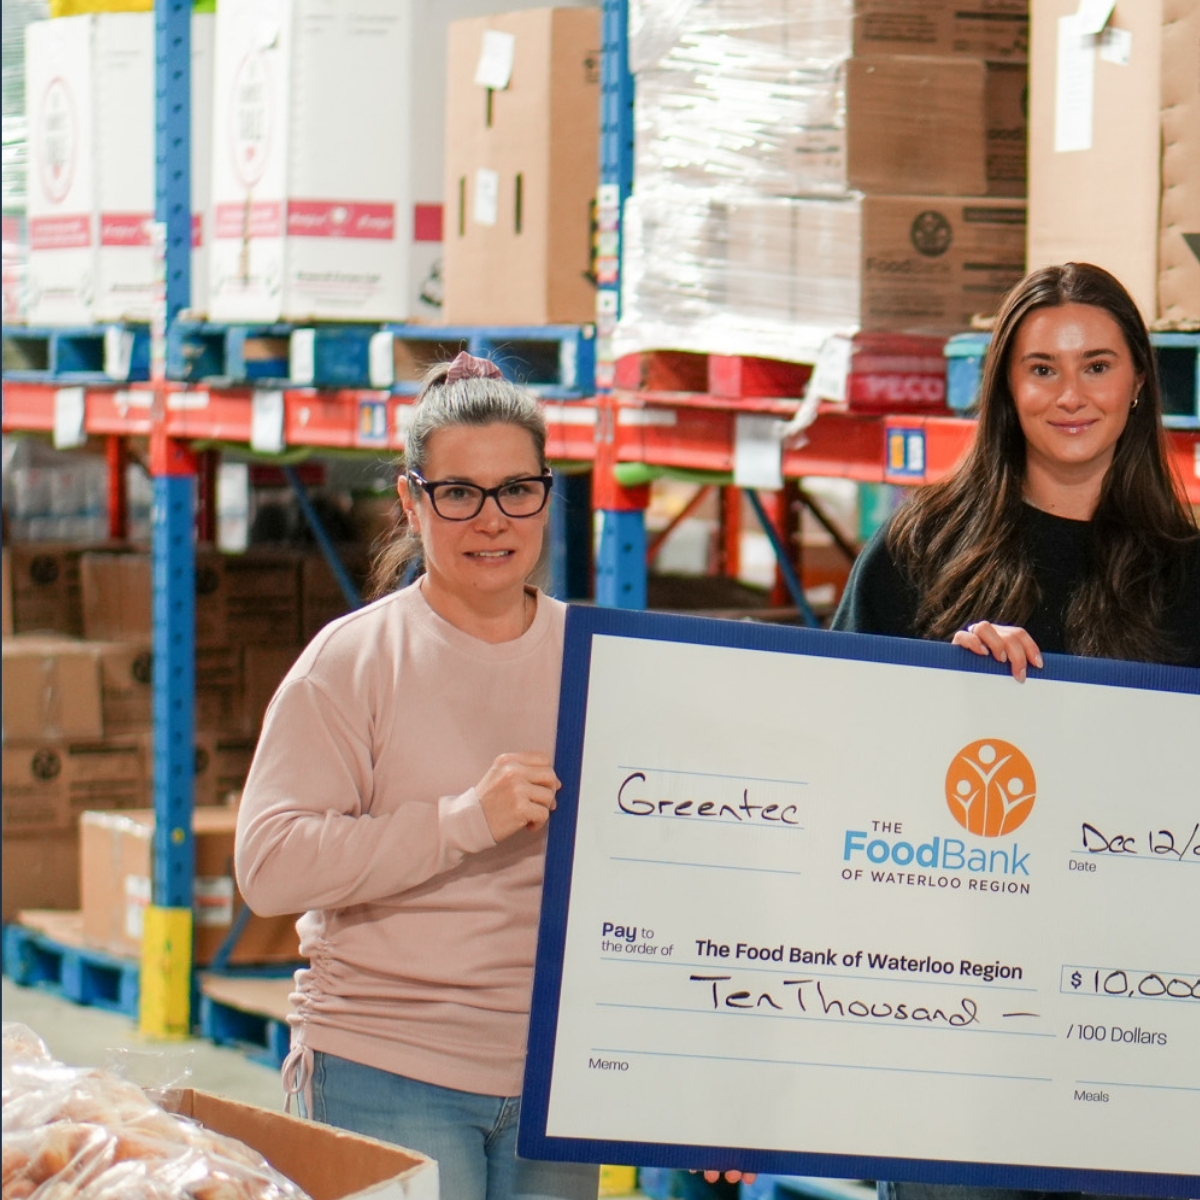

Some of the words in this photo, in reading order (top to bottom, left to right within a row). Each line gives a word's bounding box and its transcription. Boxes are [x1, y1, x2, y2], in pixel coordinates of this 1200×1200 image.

[617, 772, 800, 825] Greentec
[872, 820, 903, 834] THE
[843, 829, 1032, 876] FoodBank
[1068, 859, 1097, 873] Date
[841, 867, 864, 881] OF
[871, 870, 962, 890] WATERLOO
[968, 878, 1031, 895] REGION
[602, 921, 638, 943] Pay
[641, 927, 655, 939] to
[601, 940, 623, 953] the
[625, 942, 659, 956] order
[660, 943, 675, 956] of
[695, 938, 731, 958] The
[735, 943, 785, 963] Food
[789, 946, 838, 967] Bank
[842, 950, 862, 968] of
[867, 952, 955, 975] Waterloo
[959, 959, 1023, 982] Region
[689, 974, 784, 1010] Ten
[783, 979, 981, 1027] Thousand
[1110, 1027, 1168, 1045] Dollars
[588, 1057, 629, 1071] Memo
[1073, 1089, 1110, 1102] Meals
